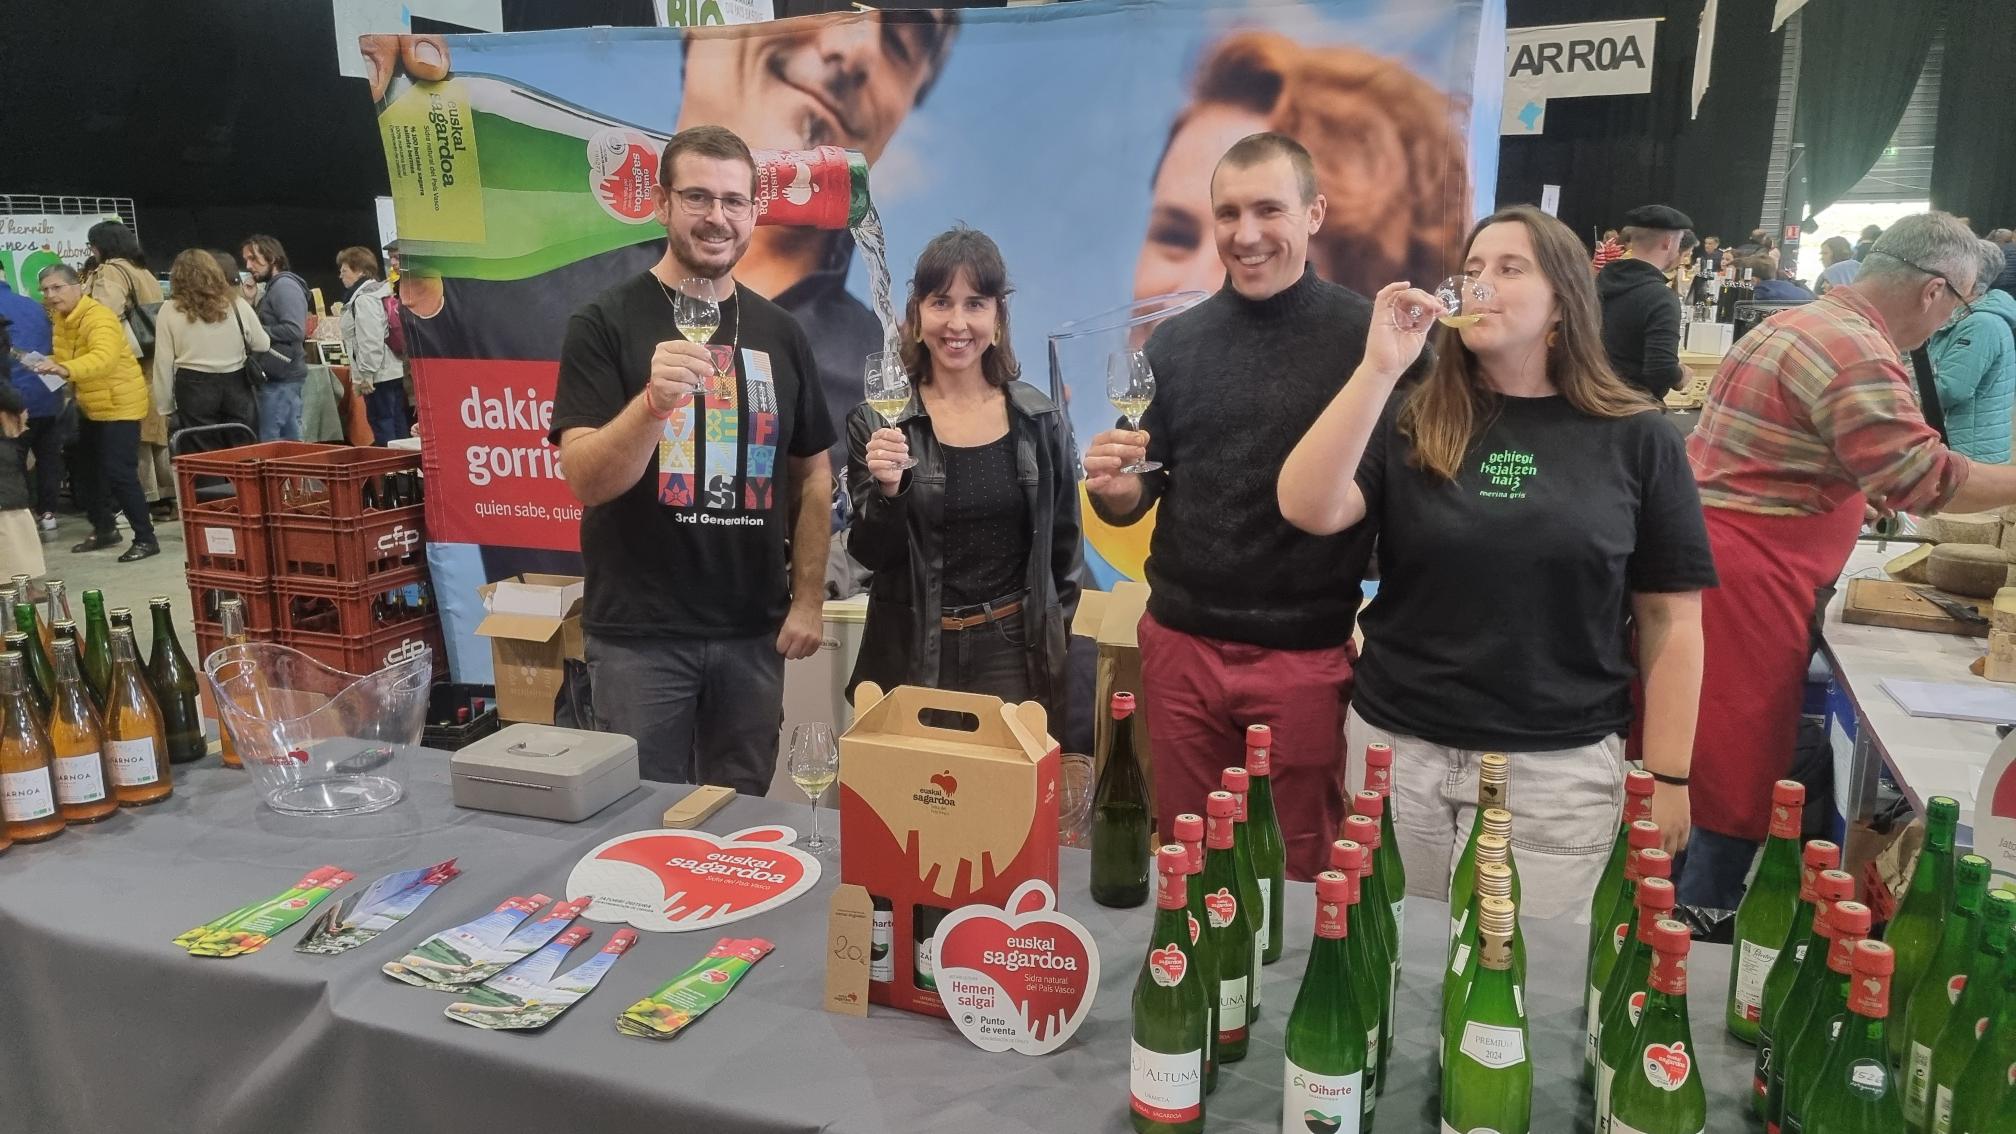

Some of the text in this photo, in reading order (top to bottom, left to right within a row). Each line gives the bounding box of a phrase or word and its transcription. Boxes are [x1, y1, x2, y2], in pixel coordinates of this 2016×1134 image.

[1507, 35, 1646, 77] ARROA
[448, 100, 466, 151] euskal
[430, 93, 455, 188] sagardoa
[632, 153, 643, 212] sagardoa
[757, 160, 770, 216] agardoa
[770, 167, 779, 200] euskal
[1489, 450, 1534, 464] gehiegi
[475, 500, 584, 522] quien sabe, quie
[676, 514, 764, 526] 3rd Generation
[913, 794, 955, 806] sagardoa
[706, 851, 776, 869] euskal
[666, 857, 786, 884] sagardoa
[706, 875, 723, 883] Sidra
[750, 882, 771, 890] Vasco
[1007, 936, 1055, 951] euskal
[983, 950, 1077, 971] sagardoa
[1024, 974, 1068, 985] Sidra natural
[952, 981, 995, 995] Hemen
[1039, 984, 1053, 992] País
[1055, 986, 1075, 994] Vasco
[958, 995, 995, 1009] salgai
[1221, 995, 1245, 1006] UNA
[980, 1016, 1005, 1026] Punto
[980, 1025, 1016, 1035] de venta
[1589, 1033, 1598, 1048] ET
[1486, 1050, 1502, 1059] 2024
[1146, 1068, 1198, 1082] ALTUNA
[1309, 1083, 1352, 1096] Oiharte
